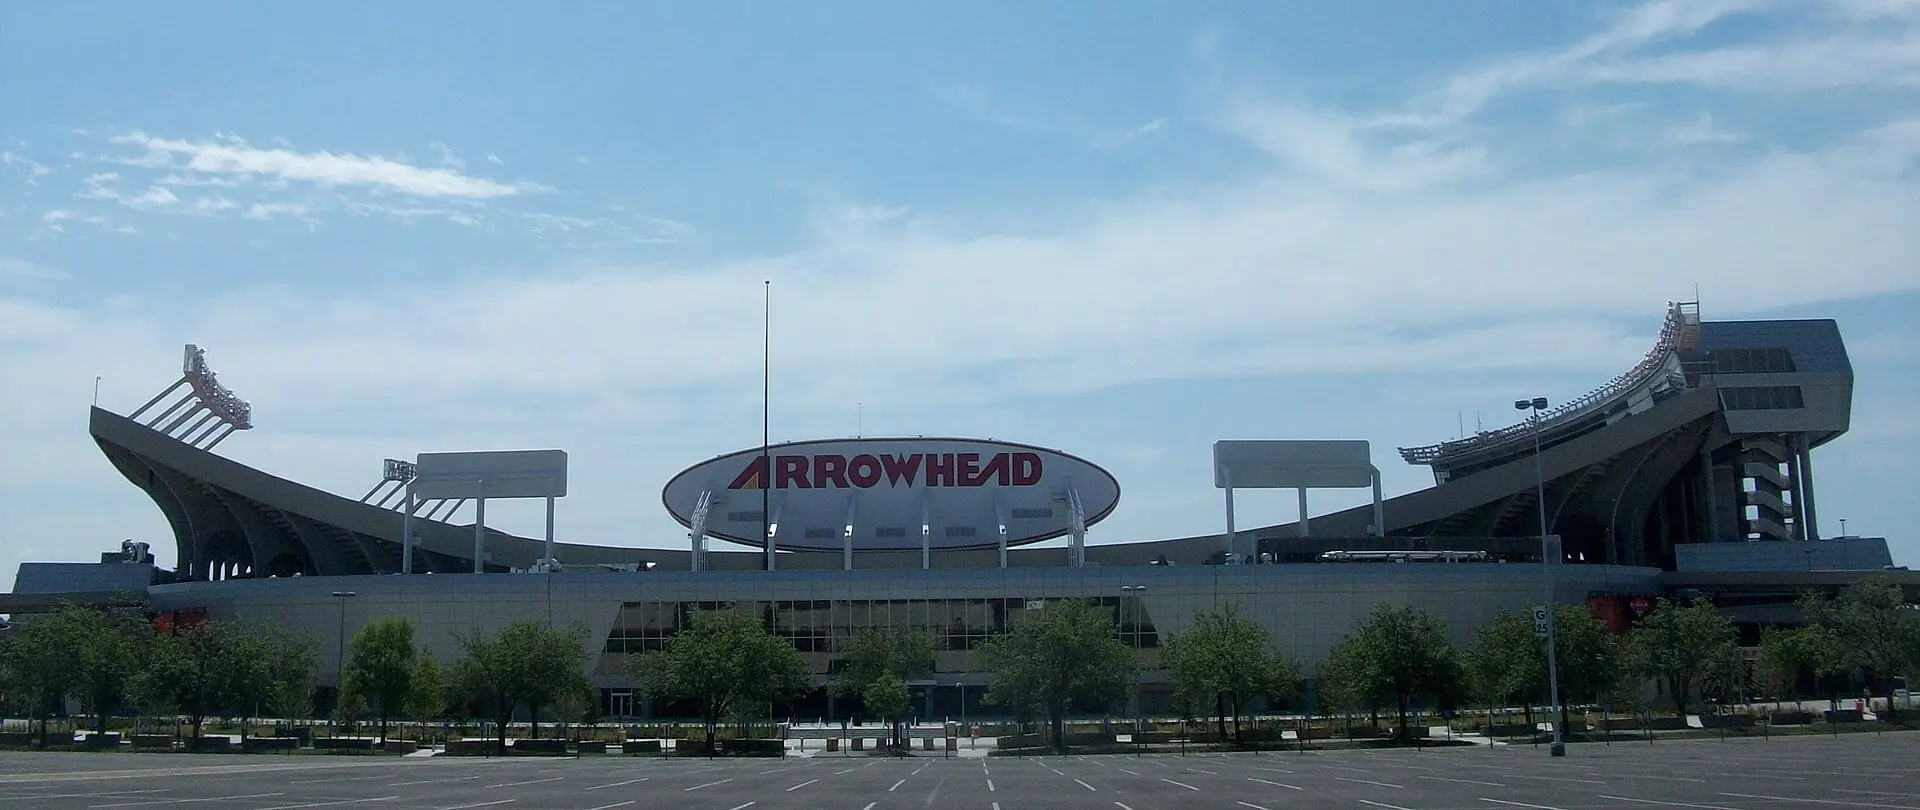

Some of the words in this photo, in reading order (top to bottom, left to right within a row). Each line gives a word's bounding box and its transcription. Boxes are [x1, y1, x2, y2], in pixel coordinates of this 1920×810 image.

[727, 452, 1043, 489] ARROWHEAD
[1535, 610, 1546, 620] G
[1536, 623, 1548, 634] 25
